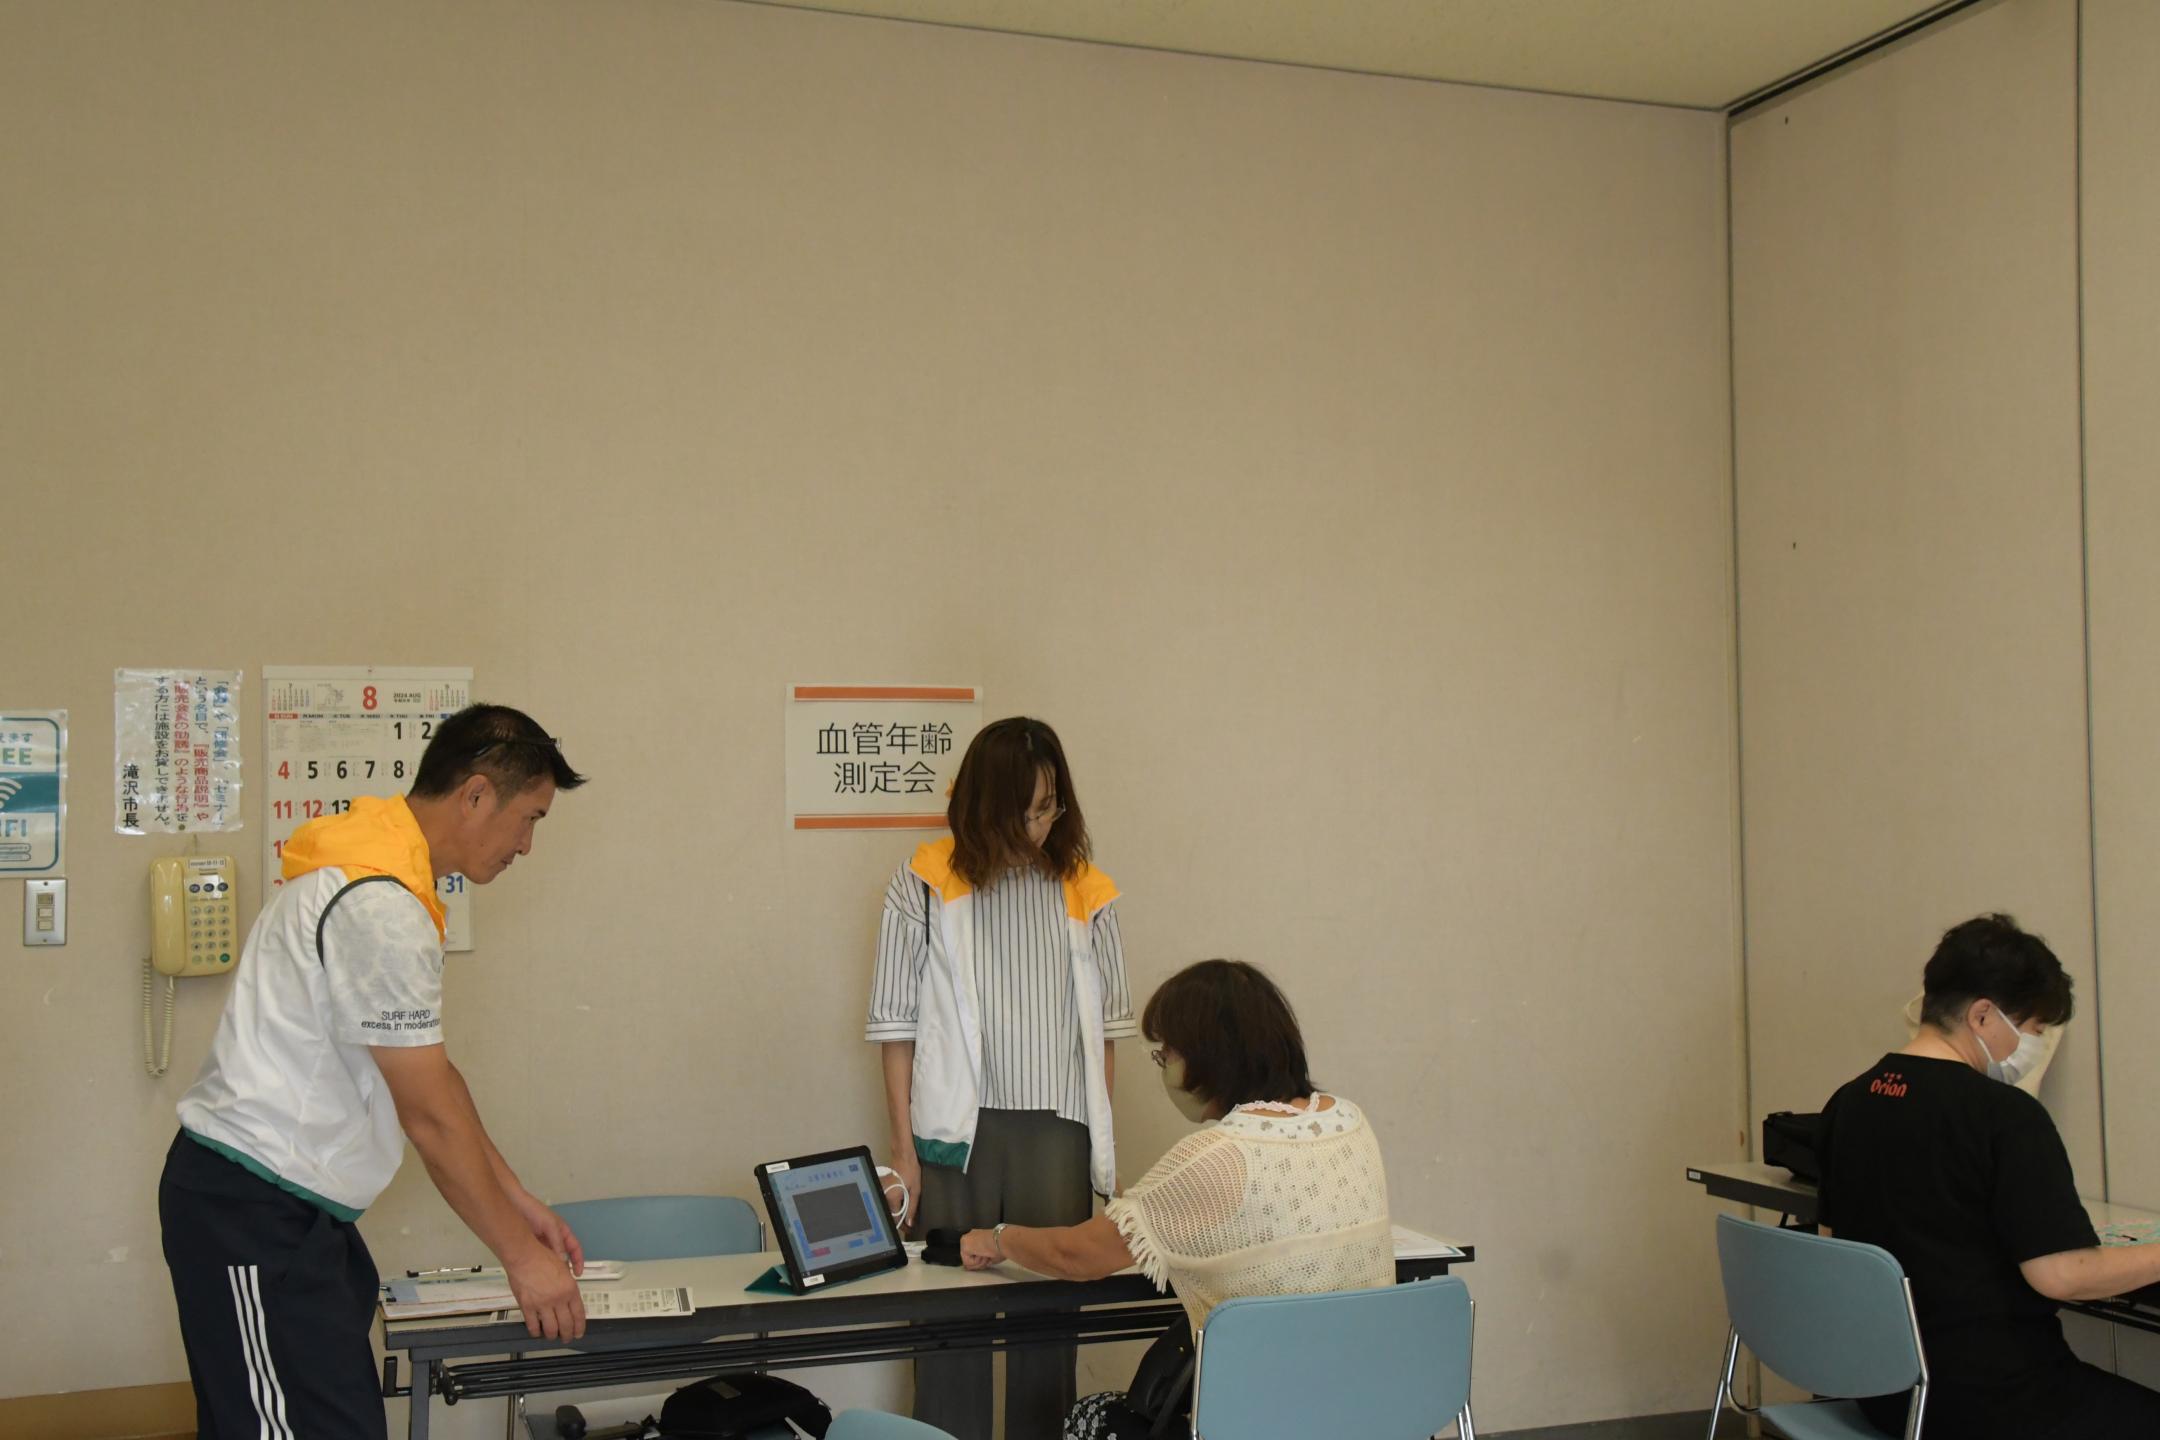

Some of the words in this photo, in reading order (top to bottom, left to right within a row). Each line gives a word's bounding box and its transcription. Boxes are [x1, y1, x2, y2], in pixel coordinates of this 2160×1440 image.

[362, 685, 378, 711] 8
[394, 722, 402, 740] 1
[421, 721, 432, 740] 2
[816, 722, 952, 755] 血管年齢
[278, 761, 290, 780] 4
[307, 761, 318, 779] 5
[336, 761, 348, 779] 6
[365, 761, 375, 779] 7
[393, 760, 404, 779] 8
[834, 761, 936, 794] 測定会
[122, 762, 140, 828] 滝沢市長
[273, 800, 292, 819] 11
[302, 800, 323, 818] 12
[0, 819, 27, 837] FI
[273, 840, 288, 858] 1
[445, 876, 464, 893] 31
[381, 1011, 406, 1021] SURF
[408, 1009, 431, 1020] HARD
[361, 1020, 391, 1031] excess
[394, 1021, 402, 1030] in
